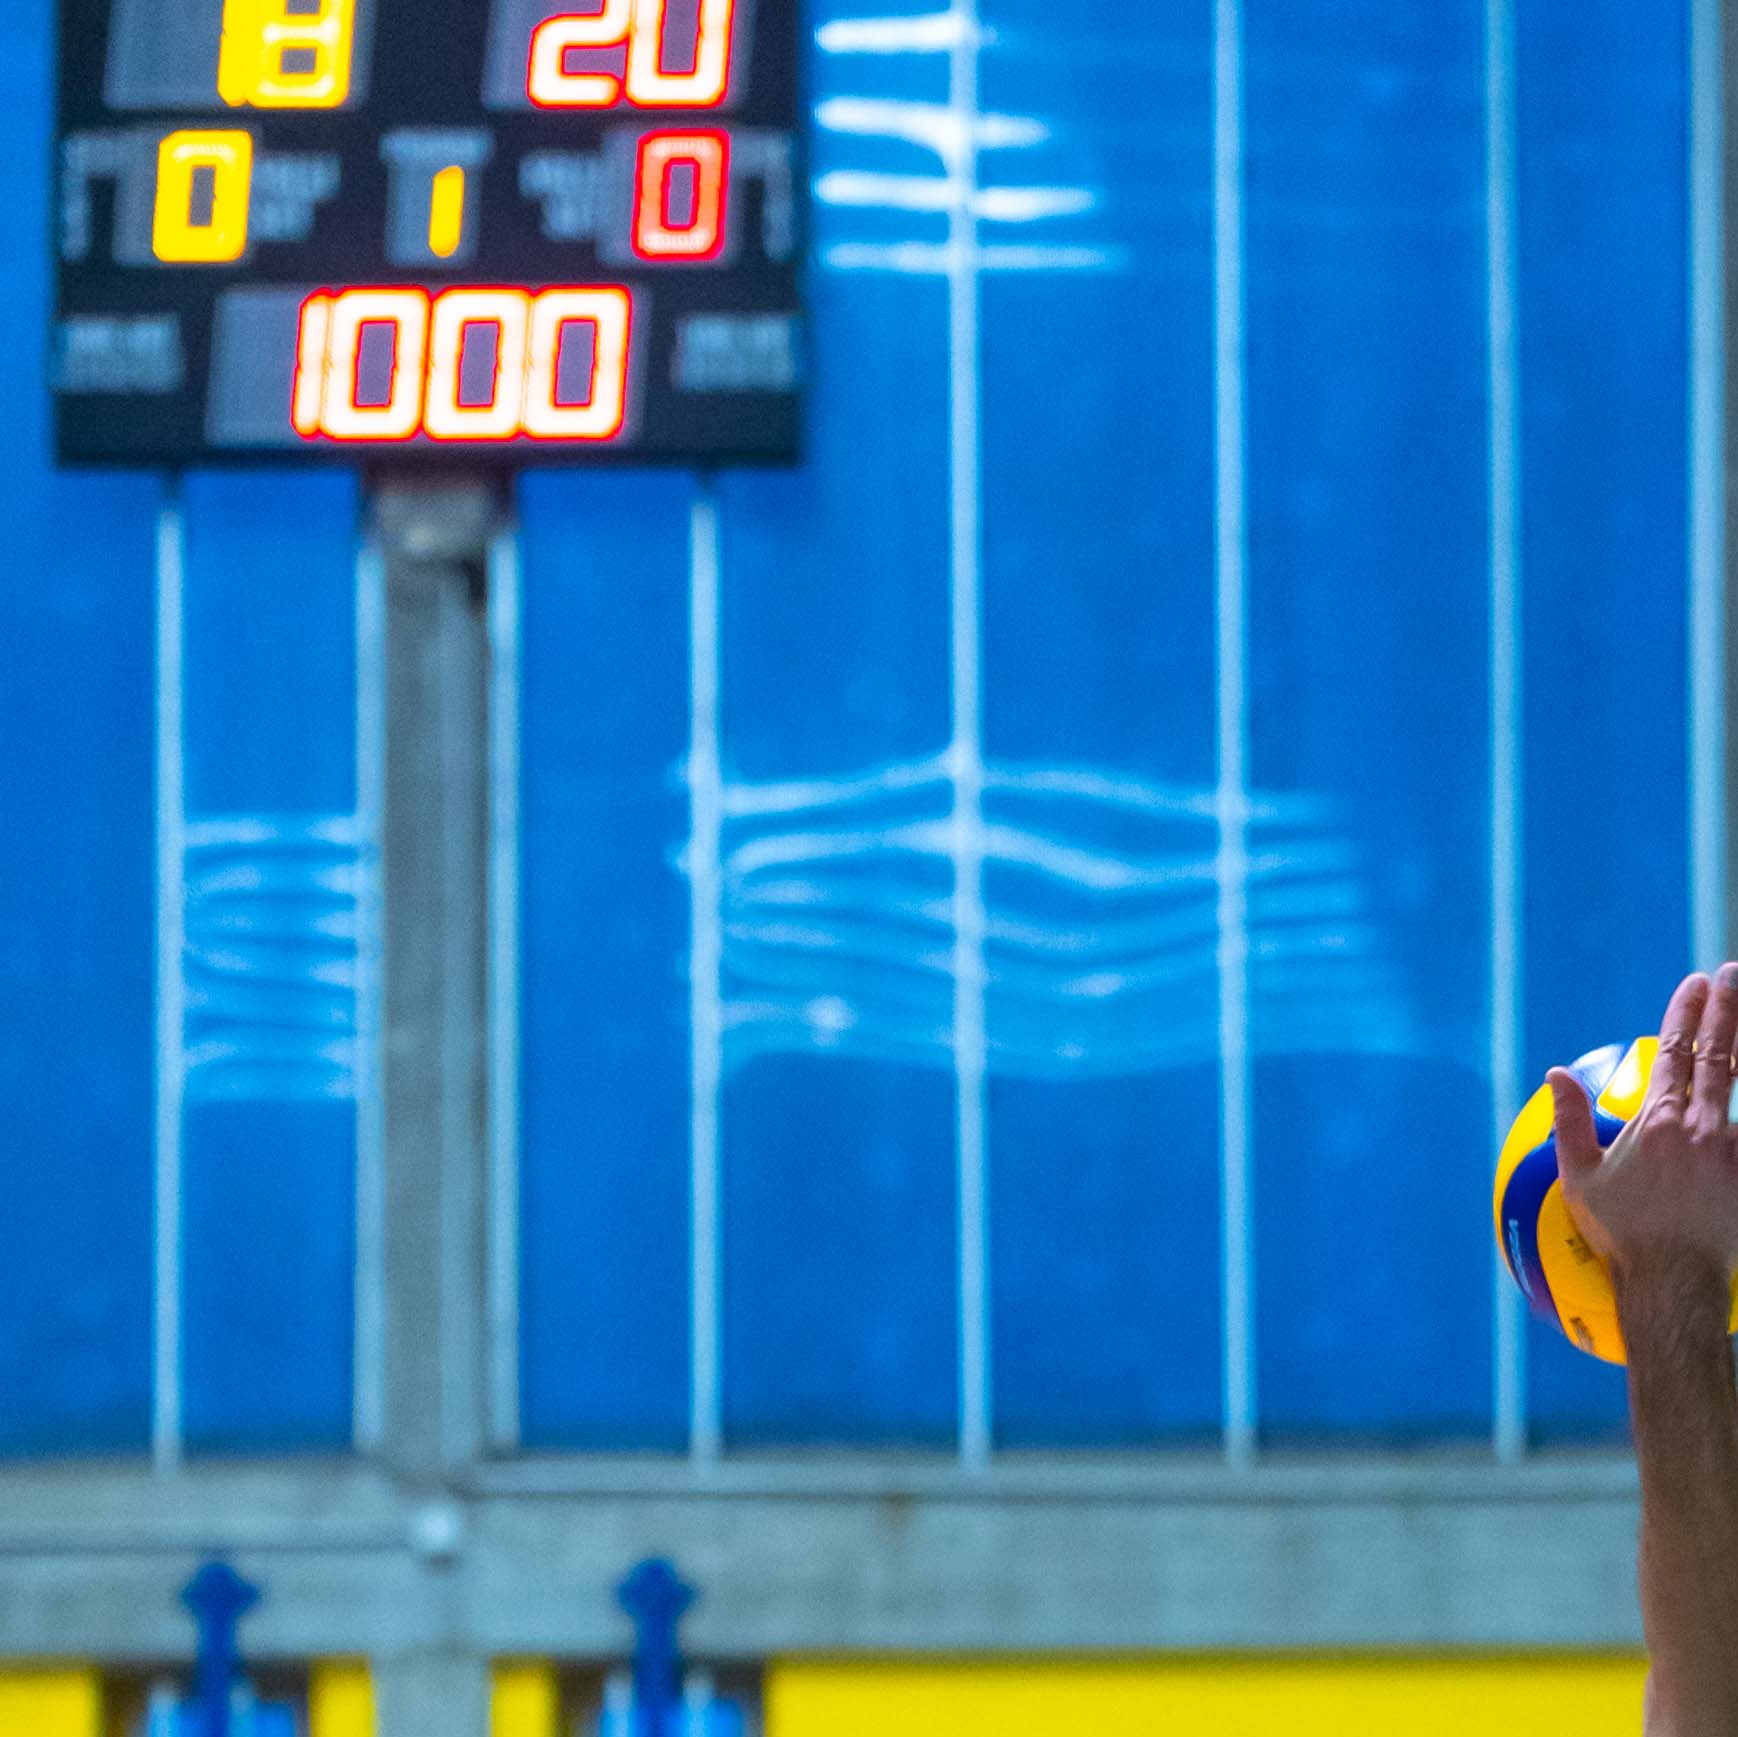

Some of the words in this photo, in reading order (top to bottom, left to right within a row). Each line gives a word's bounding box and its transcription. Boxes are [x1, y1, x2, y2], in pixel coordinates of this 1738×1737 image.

[528, 0, 734, 109] 20
[153, 129, 253, 262] 0
[428, 165, 465, 258] 1
[631, 128, 730, 261] 0
[291, 285, 632, 441] 1000
